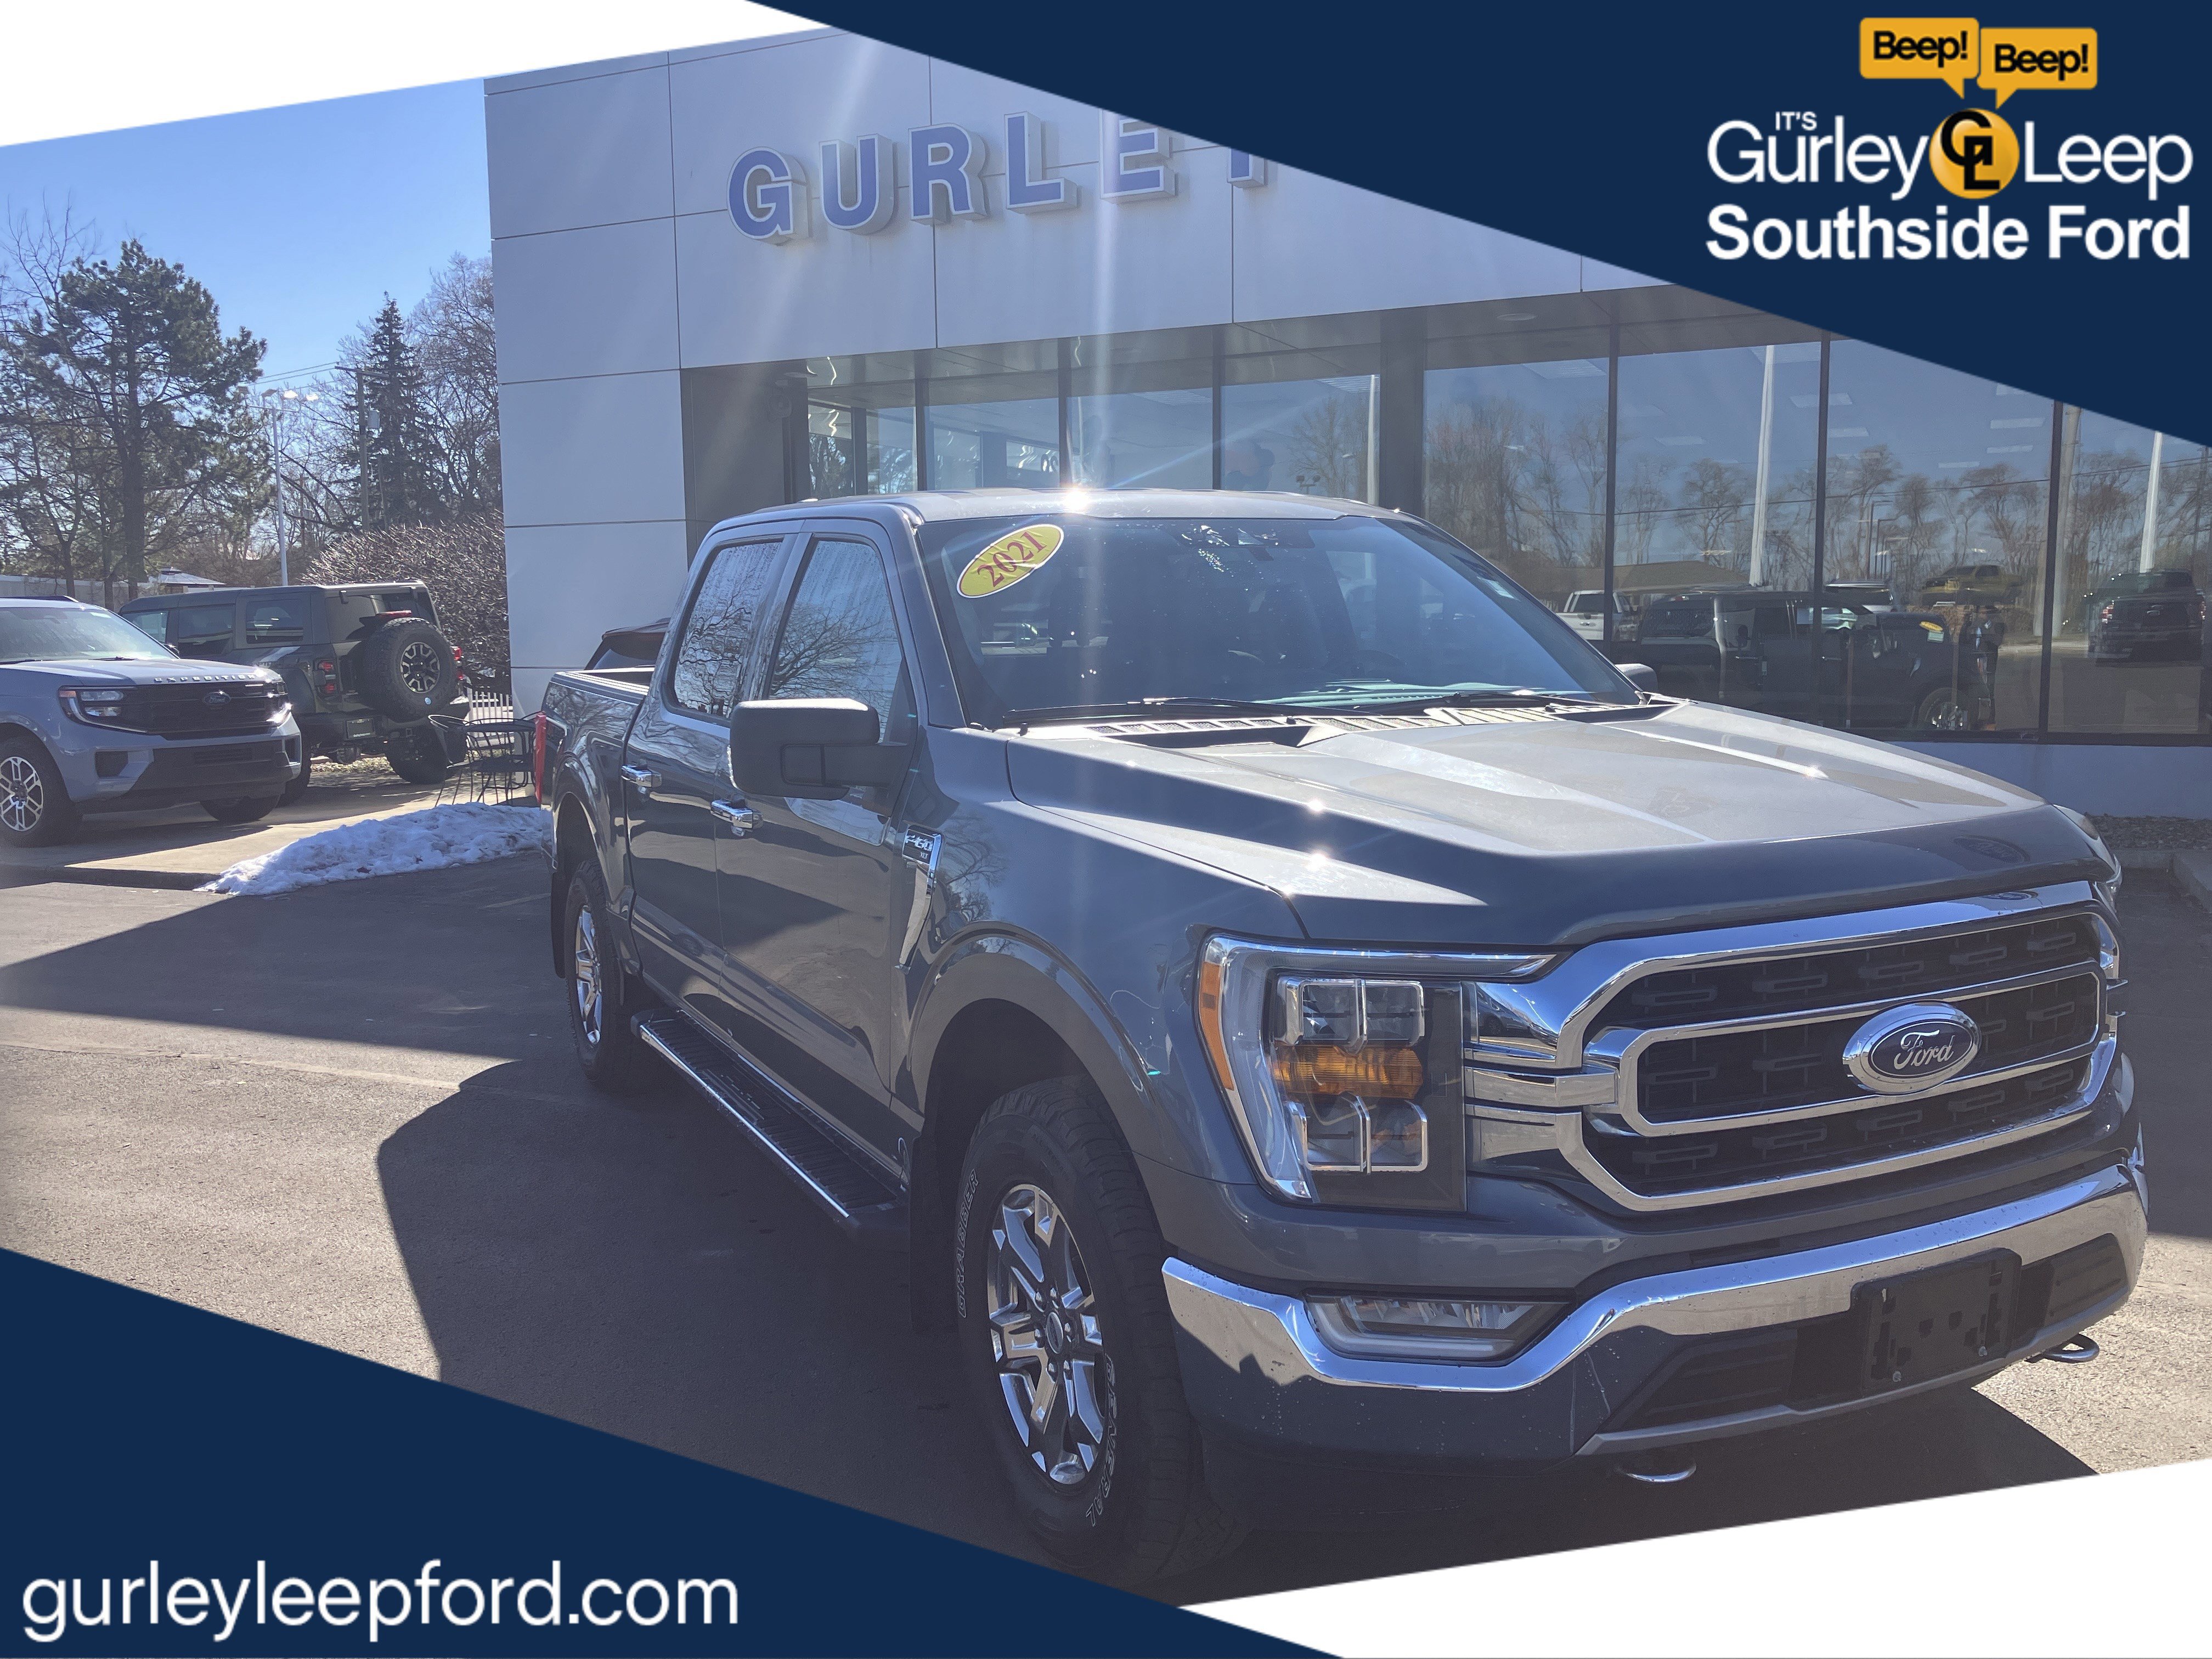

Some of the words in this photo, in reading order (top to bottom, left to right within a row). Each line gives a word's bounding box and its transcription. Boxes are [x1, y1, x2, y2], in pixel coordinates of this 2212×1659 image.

[977, 532, 1047, 587] 2021
[154, 674, 256, 682] EXPEDITION
[1894, 1029, 1955, 1070] Ford
[957, 1169, 979, 1318] GRABBER
